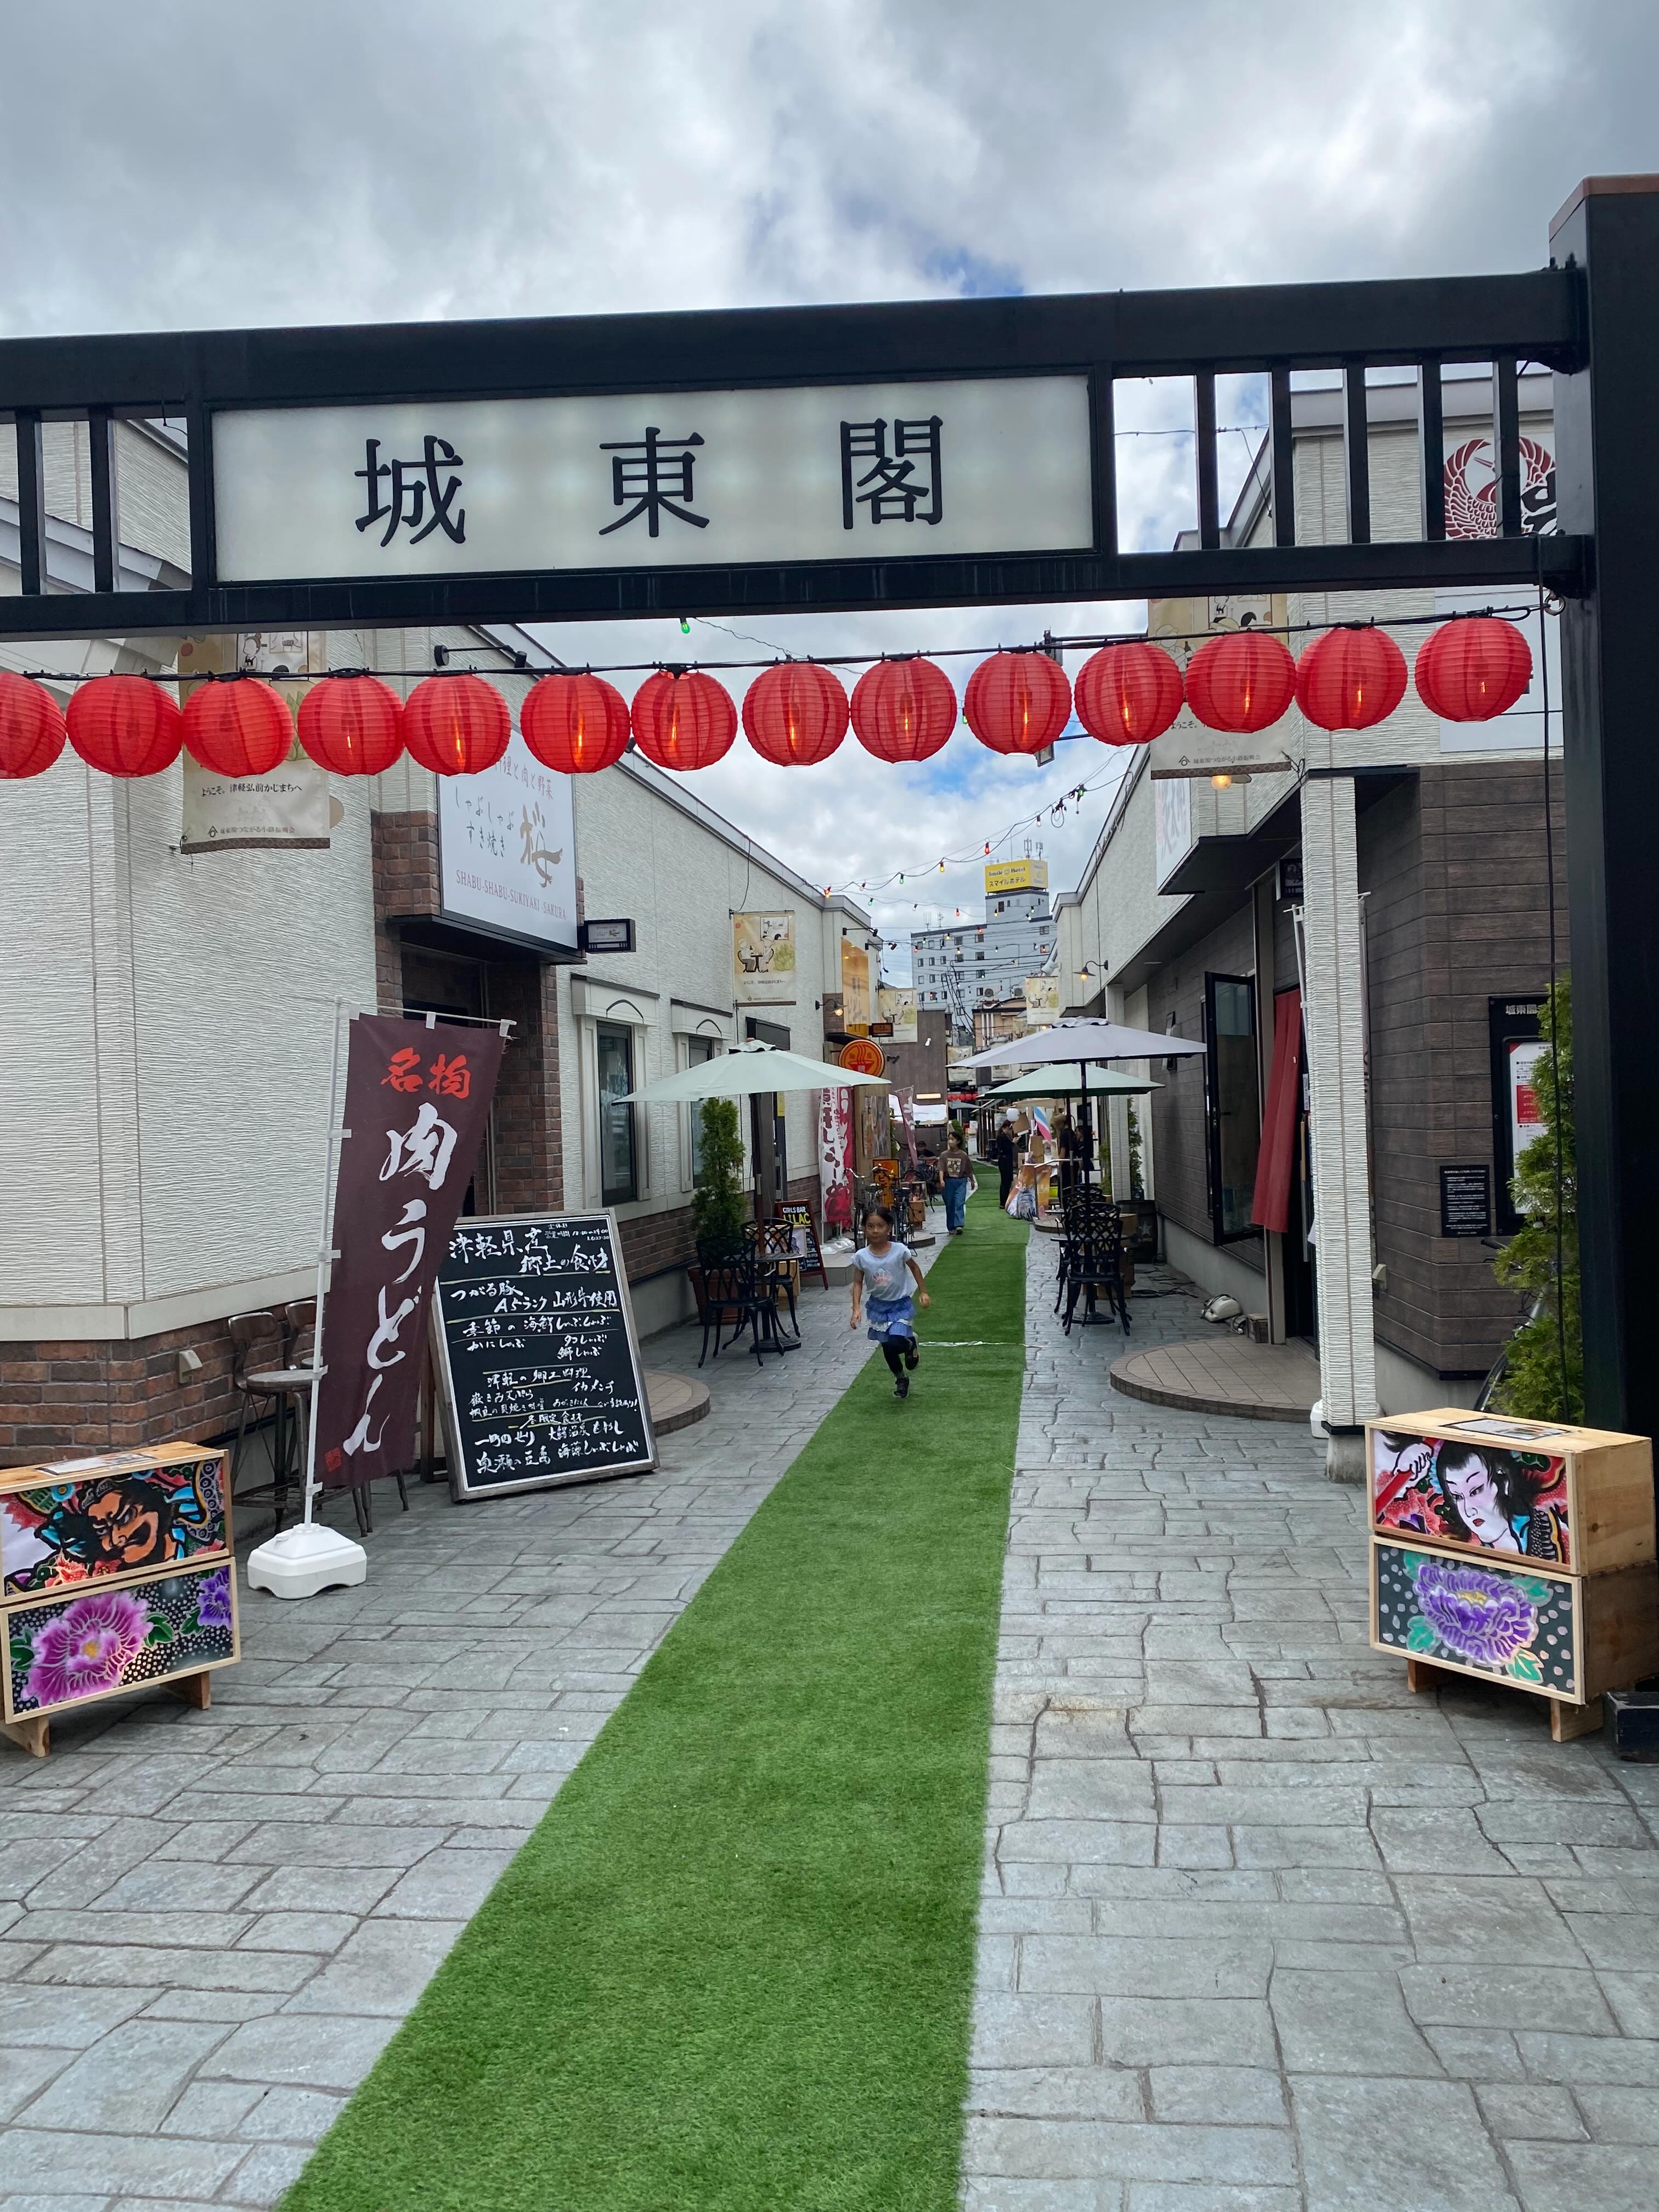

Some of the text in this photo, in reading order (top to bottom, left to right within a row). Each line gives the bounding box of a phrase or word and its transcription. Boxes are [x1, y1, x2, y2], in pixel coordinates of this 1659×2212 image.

[354, 414, 944, 548] 城東閣
[456, 786, 514, 831] しゃぶしゃぶ
[466, 821, 505, 858] すき焼き
[989, 877, 1026, 887] スマイルホテル
[380, 1047, 471, 1099] 名物
[518, 1243, 608, 1276] 郷土の食材
[343, 1102, 458, 1455] 肉うどん
[450, 1280, 523, 1301] つがる豚
[494, 1286, 618, 1312] A5ランク 山形牛使用
